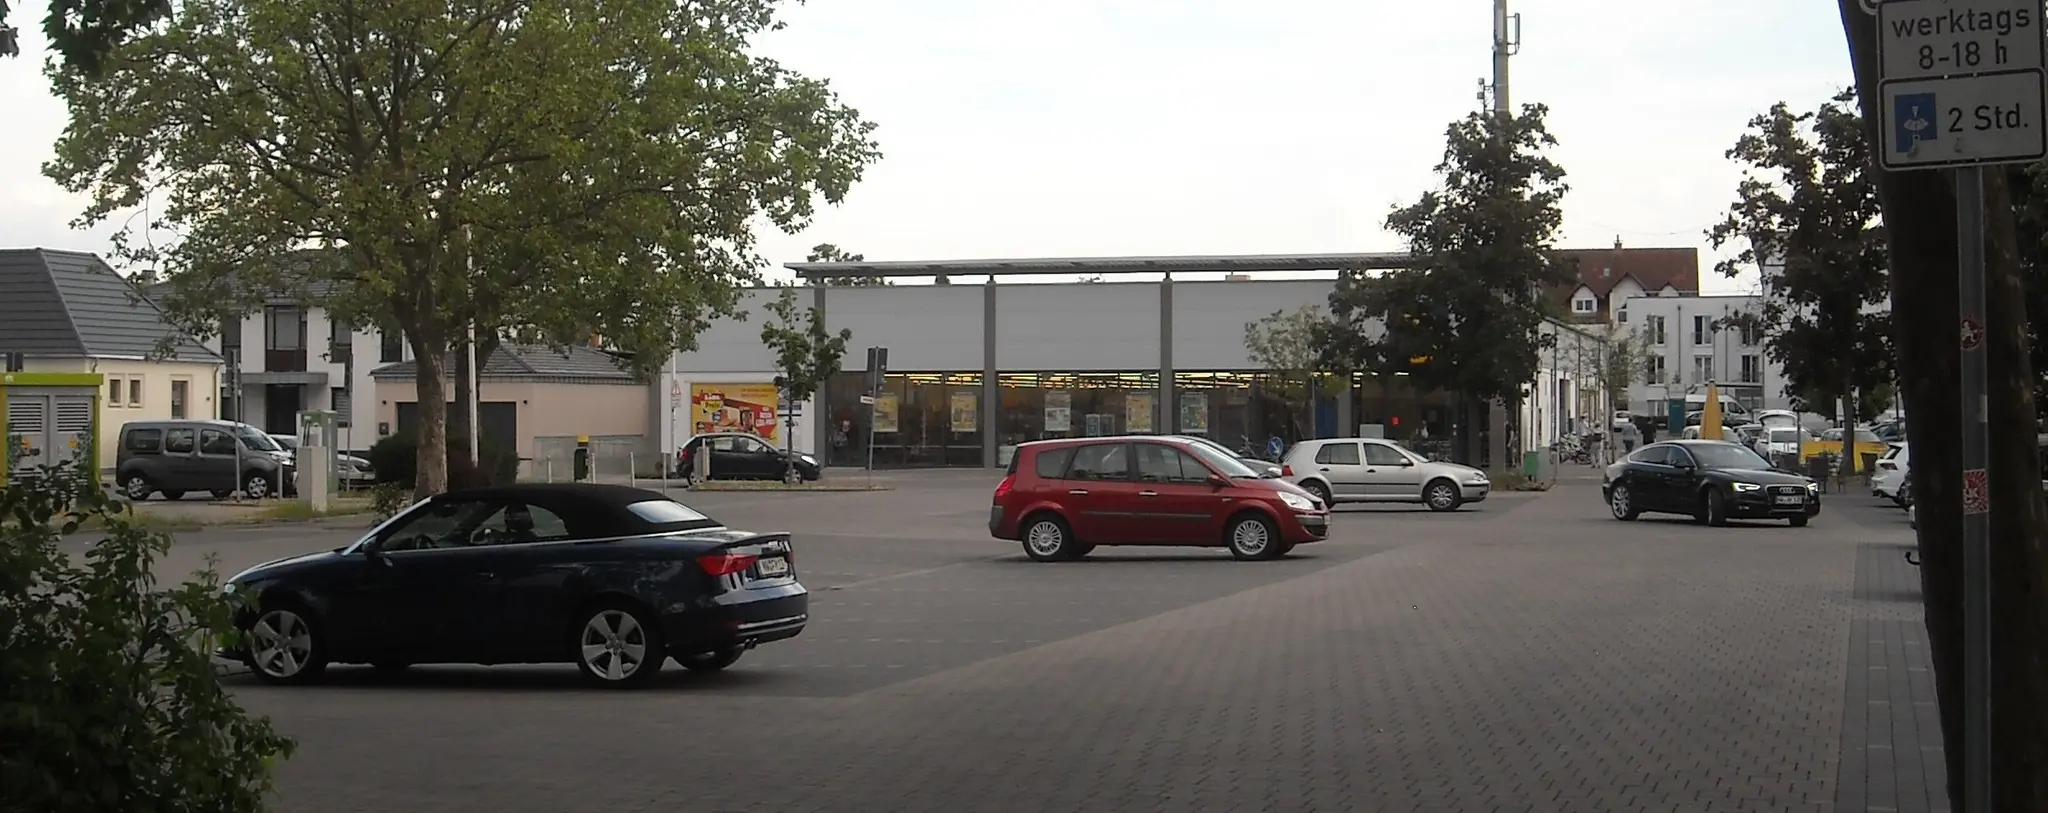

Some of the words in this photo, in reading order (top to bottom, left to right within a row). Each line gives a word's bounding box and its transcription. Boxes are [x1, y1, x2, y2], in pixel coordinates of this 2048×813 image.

[1892, 8, 2030, 38] werktags
[1919, 41, 1981, 70] 8-18
[1995, 39, 2008, 65] h
[1948, 107, 1963, 133] 2
[1974, 103, 2029, 131] Std.
